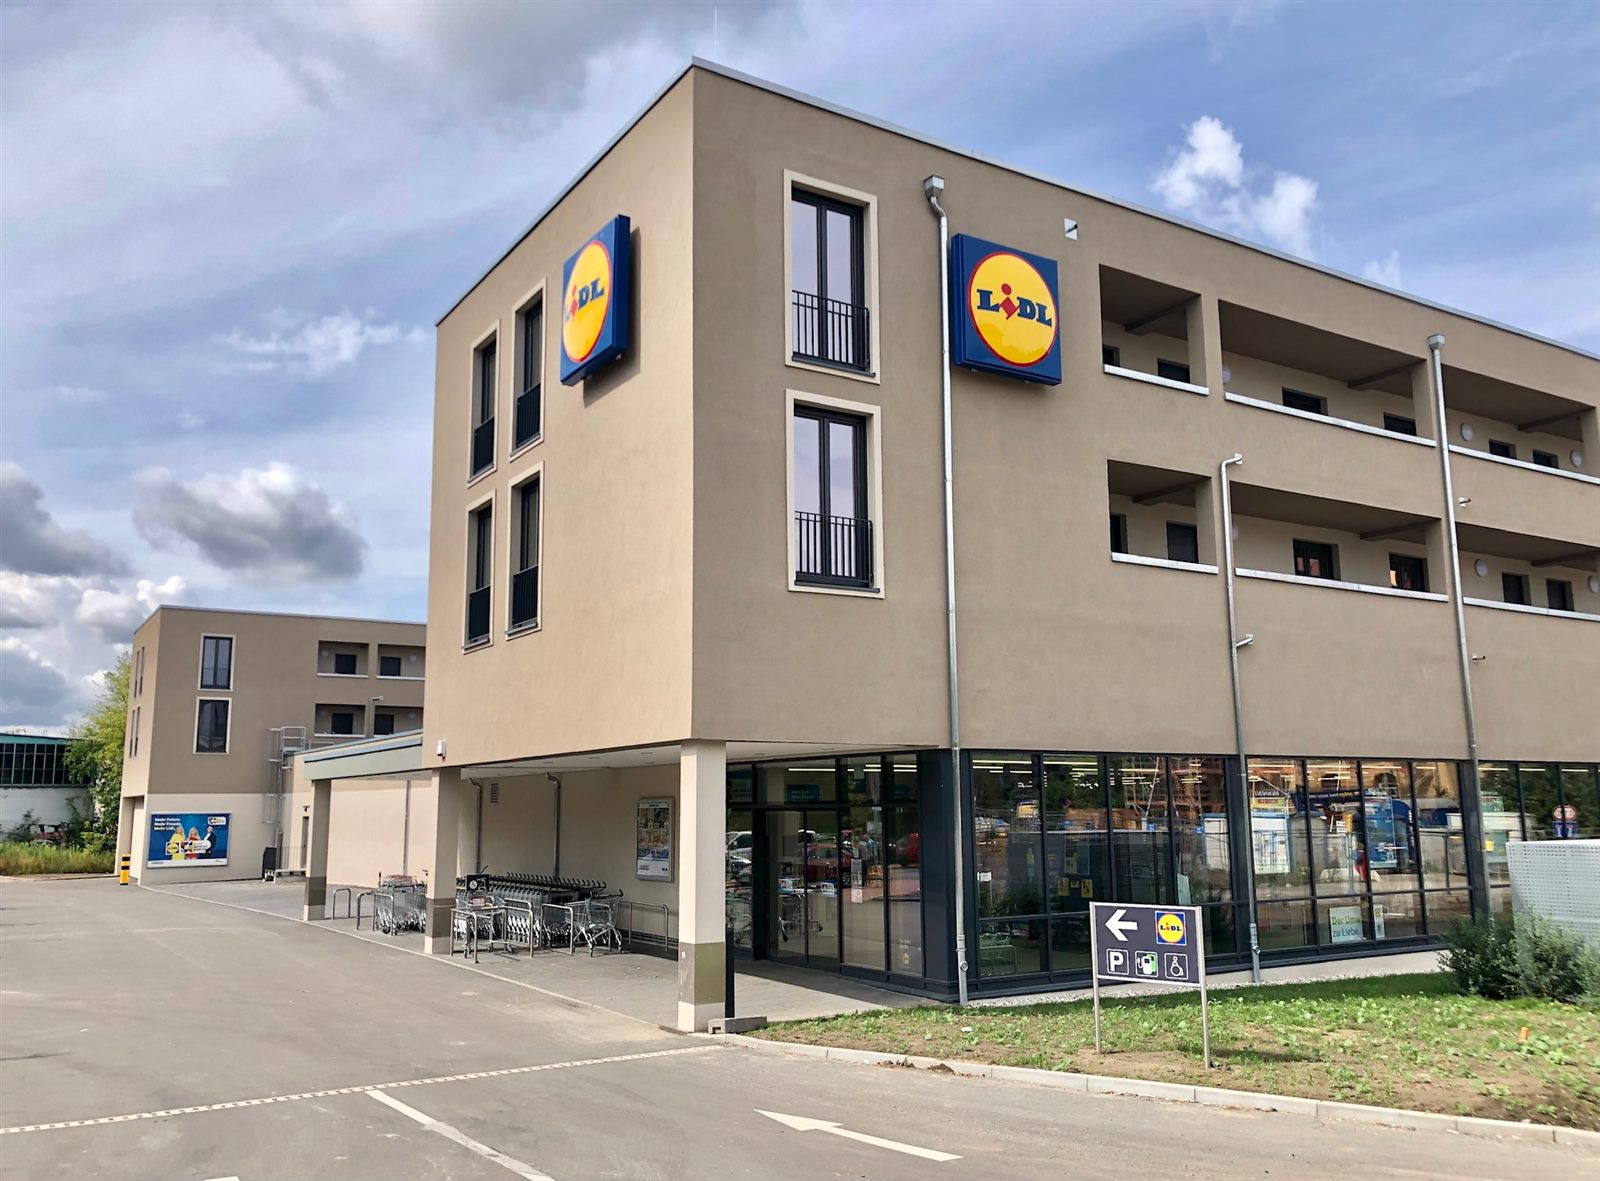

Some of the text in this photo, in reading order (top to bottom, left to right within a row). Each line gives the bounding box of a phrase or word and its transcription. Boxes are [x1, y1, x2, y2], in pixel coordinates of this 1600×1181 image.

[976, 283, 1053, 328] LiDL
[1160, 922, 1183, 931] LiDL
[1109, 951, 1124, 972] P
